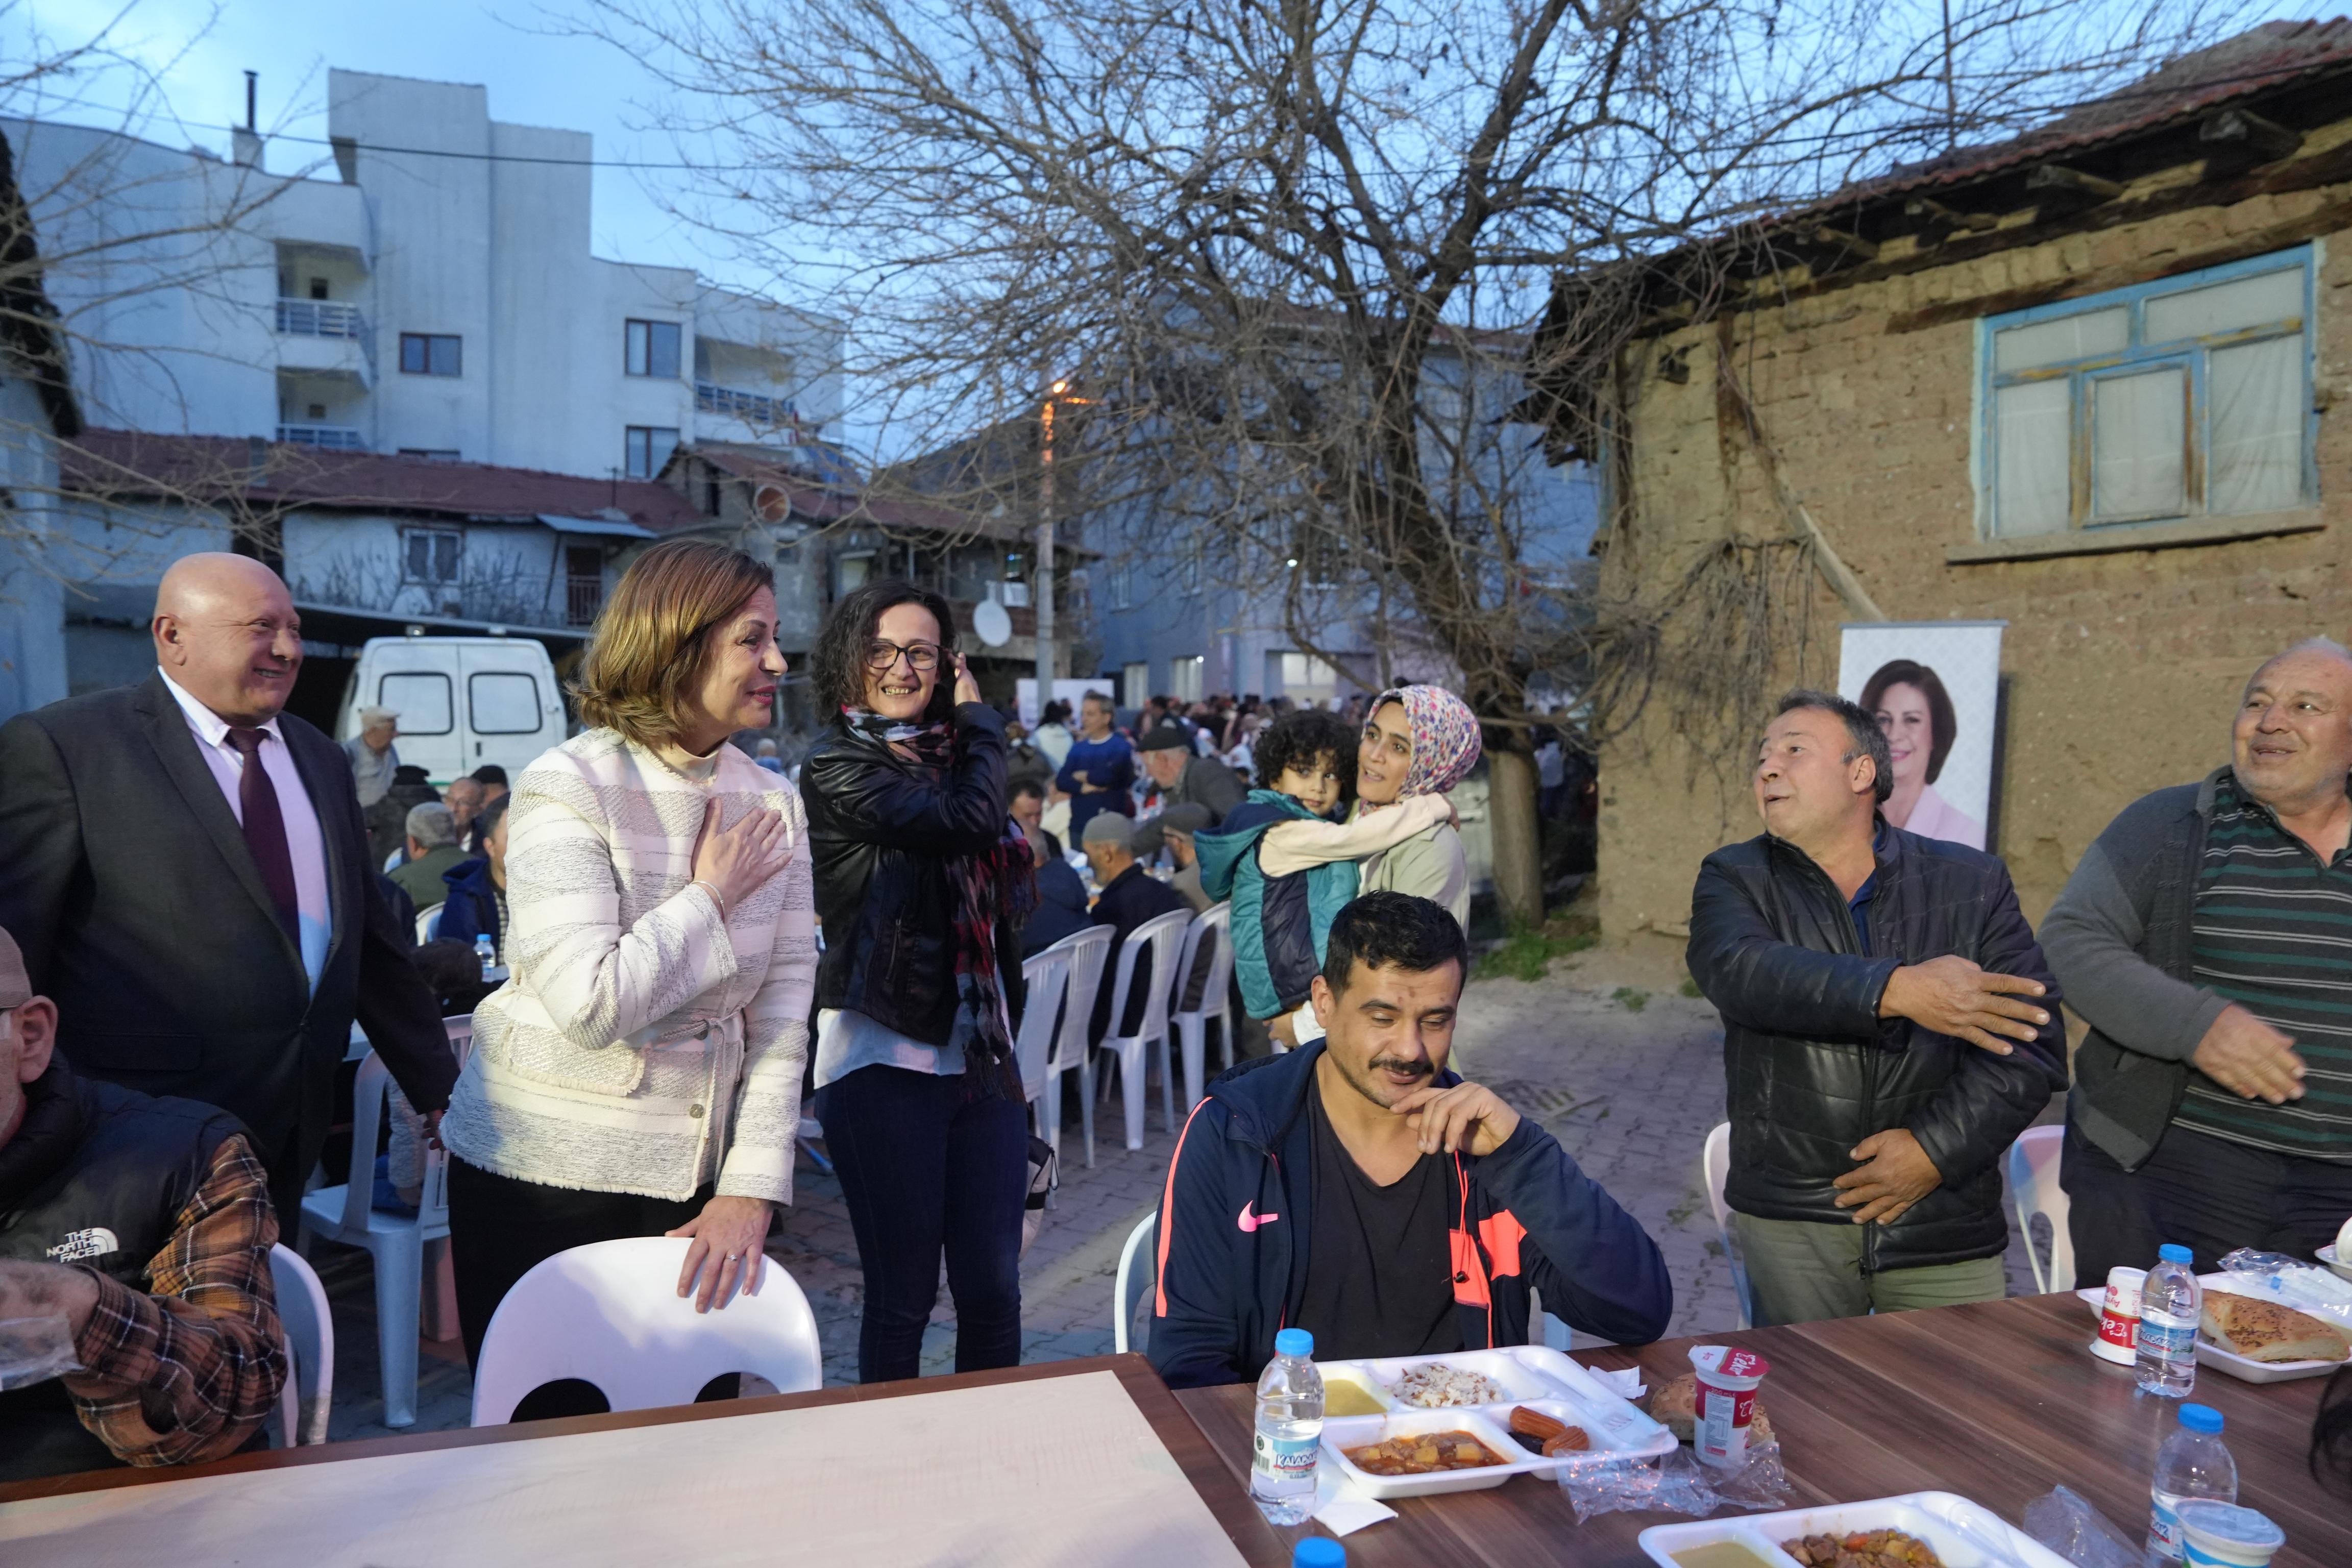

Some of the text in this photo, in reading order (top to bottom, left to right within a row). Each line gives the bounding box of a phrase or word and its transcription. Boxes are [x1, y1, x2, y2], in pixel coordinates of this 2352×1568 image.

[65, 1228, 92, 1243] THE
[46, 1237, 93, 1258] NORTH
[60, 1246, 94, 1263] FACE
